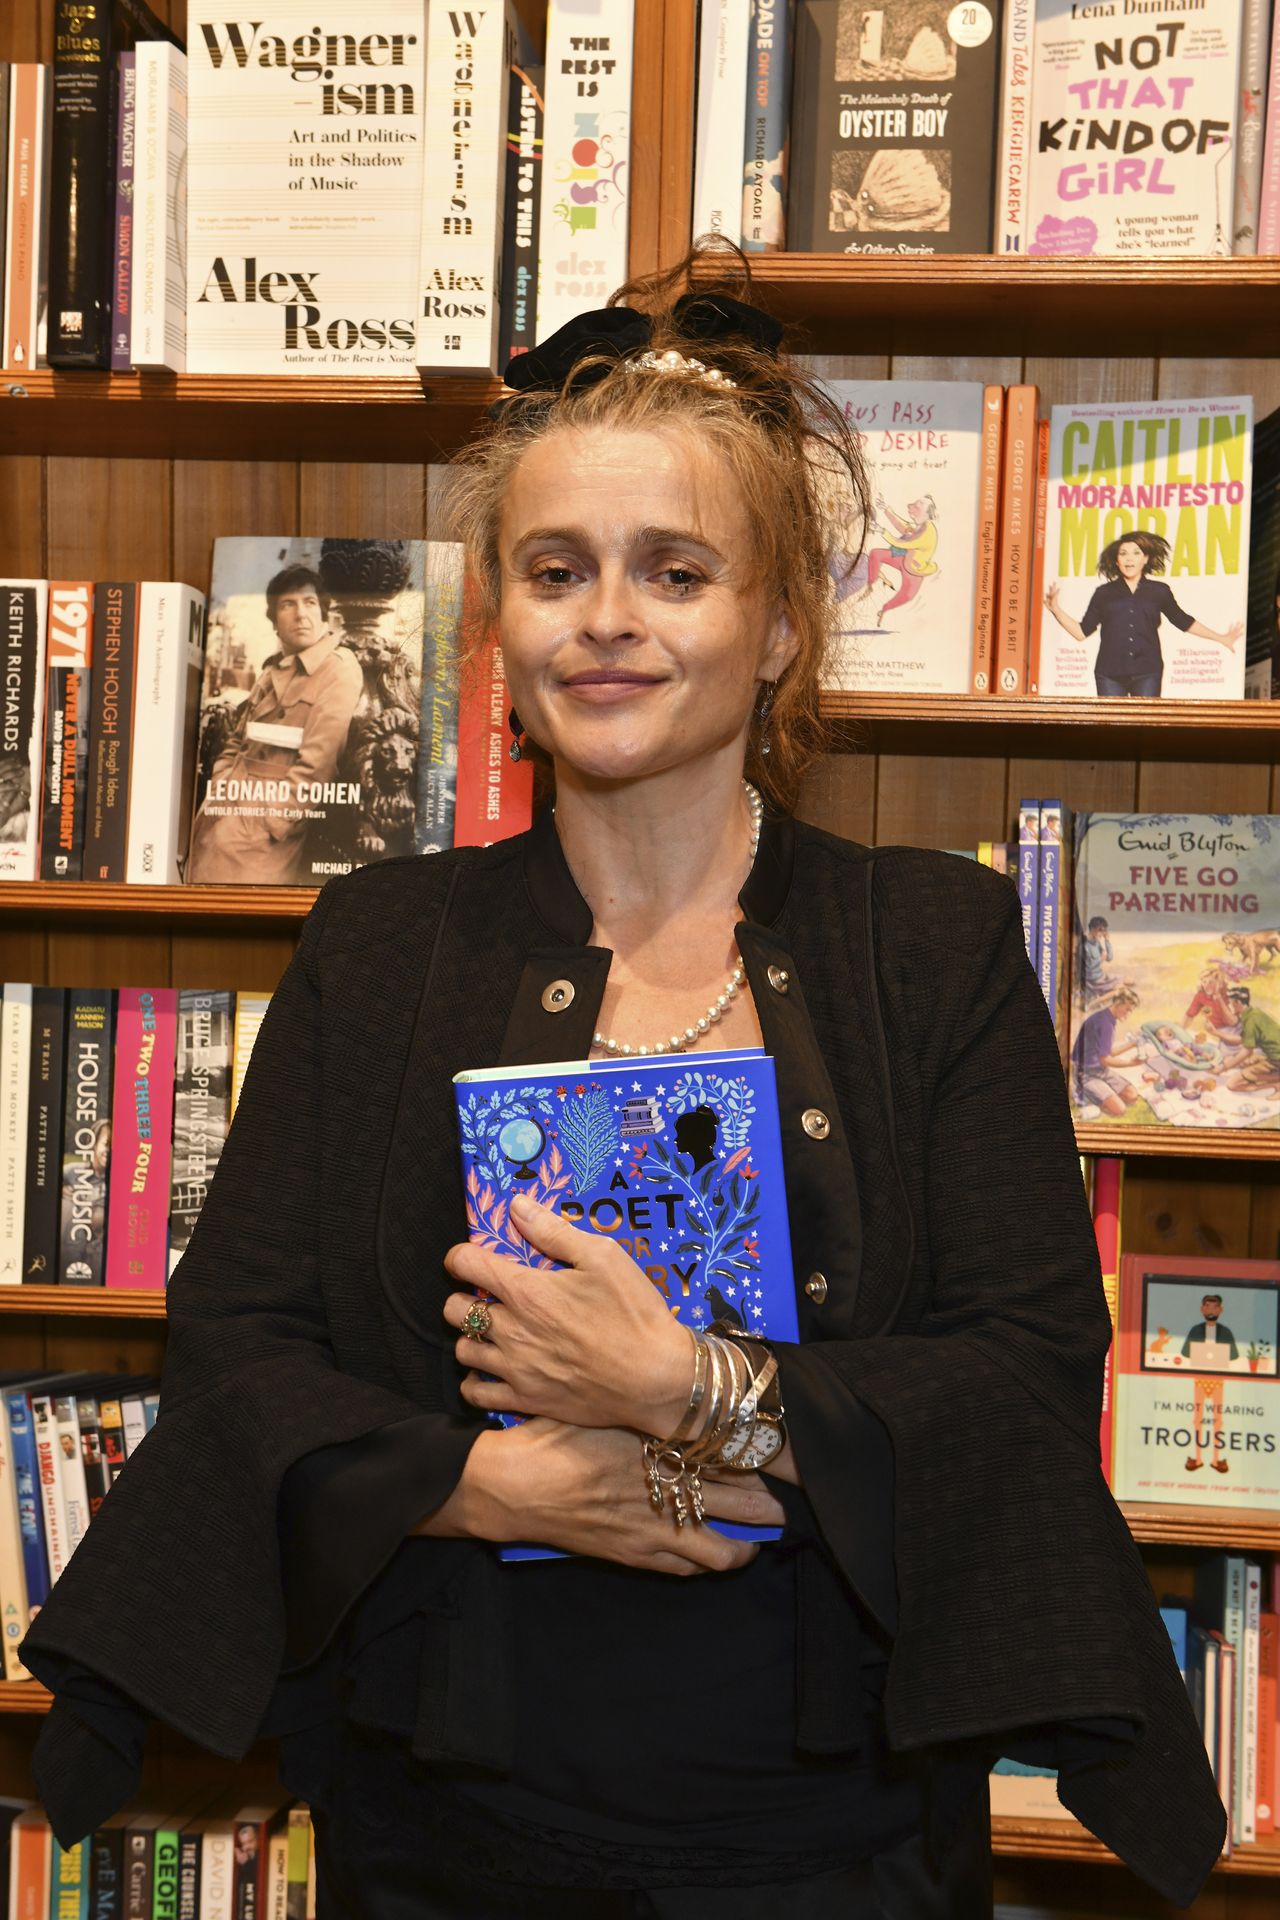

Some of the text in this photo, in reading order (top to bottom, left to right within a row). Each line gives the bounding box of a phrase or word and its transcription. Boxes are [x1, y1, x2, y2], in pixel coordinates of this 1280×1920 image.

[61, 5, 96, 19] Jazz
[962, 9, 976, 25] 20
[1071, 0, 1205, 20] Lena Dunham
[70, 18, 84, 33] &
[57, 36, 100, 50] Blues
[198, 22, 417, 82] Wagner
[570, 38, 610, 51] THE
[1095, 22, 1185, 70] NOT
[560, 60, 616, 75] REST
[756, 52, 770, 76] ON
[577, 81, 598, 98] IS
[756, 79, 769, 107] TOP
[1068, 76, 1194, 110] THAT
[122, 68, 135, 168] BEING WAGNER
[840, 110, 948, 138] OYSTER BOY
[20, 138, 29, 160] PAUL
[289, 128, 417, 143] Art and Politics
[754, 118, 766, 168] RICHARD
[289, 152, 404, 167] in the Shadow
[516, 85, 537, 248] LISTEN TO THIS
[1007, 96, 1025, 224] KEGGIE CAREW
[20, 164, 28, 196] KILDEA
[289, 176, 358, 190] of Music
[753, 172, 763, 220] AYOADE
[1115, 214, 1199, 226] A young woman
[1118, 226, 1193, 238] tells you what
[18, 250, 26, 280] PIANO
[117, 215, 131, 315] SIMON CALLOW
[556, 252, 607, 276] alex
[196, 257, 320, 304] Alex
[426, 268, 486, 291] Alex
[554, 281, 607, 298] ross
[424, 296, 486, 319] Ross
[281, 304, 416, 350] Ross
[282, 354, 416, 364] Author of The Rest is Noise
[844, 401, 934, 424] BUS PASS
[1072, 409, 1114, 417] Bestselling
[1117, 408, 1143, 416] author
[1156, 406, 1174, 414] How
[1208, 404, 1240, 412] Woman
[880, 430, 950, 452] DESIRE
[1062, 414, 1246, 487] CAITLIN
[1058, 480, 1244, 508] MORANIFESTO
[978, 424, 998, 658] GEORGE MIKES English Humour for Beginners
[1007, 440, 1024, 652] GEORGE MIKES HOW TO BE A BRIT
[50, 586, 88, 667] 1971
[4, 592, 24, 752] KEITH RICHARDS
[102, 588, 122, 733] STEPHEN HOUGH
[877, 661, 926, 670] MATTHEW
[491, 684, 504, 726] O'LEARY
[50, 710, 64, 804] DAVID HEPWORTH
[59, 673, 81, 850] NEVER A DULL MOMENT
[490, 732, 502, 766] ASHES
[106, 740, 120, 808] Rough Ideas
[489, 770, 501, 783] TO
[206, 780, 360, 804] LEONARD COHEN
[438, 776, 448, 823] JENNIFER
[488, 786, 500, 820] ASHES
[1118, 831, 1250, 856] Enid Blyton
[312, 862, 352, 874] MICHAEL
[1129, 866, 1238, 887] FIVE GO
[1109, 892, 1259, 912] PARENTING
[12, 1005, 20, 1036] YEAR
[76, 1021, 104, 1029] MASON
[12, 1041, 19, 1056] OF
[132, 992, 156, 1193] ONE TWO THREE FOUR
[187, 998, 212, 1188] BRUCE SPRINGSTEEN
[10, 1092, 18, 1142] MONKEY
[36, 1106, 48, 1186] PATTI SMITH
[70, 1042, 99, 1242] HOUSE OF MUSIC
[8, 1157, 16, 1194] PATTI
[610, 1170, 629, 1192] A
[6, 1200, 14, 1239] SMITH
[561, 1194, 684, 1233] POET
[618, 1237, 652, 1258] OR
[1154, 1401, 1264, 1416] I'M NOT WEARING
[1140, 1427, 1276, 1453] TROUSERS
[38, 1442, 61, 1574] DJANGO UNCHAINED
[210, 1840, 226, 1900] DAVID
[130, 1862, 146, 1912] Carrie
